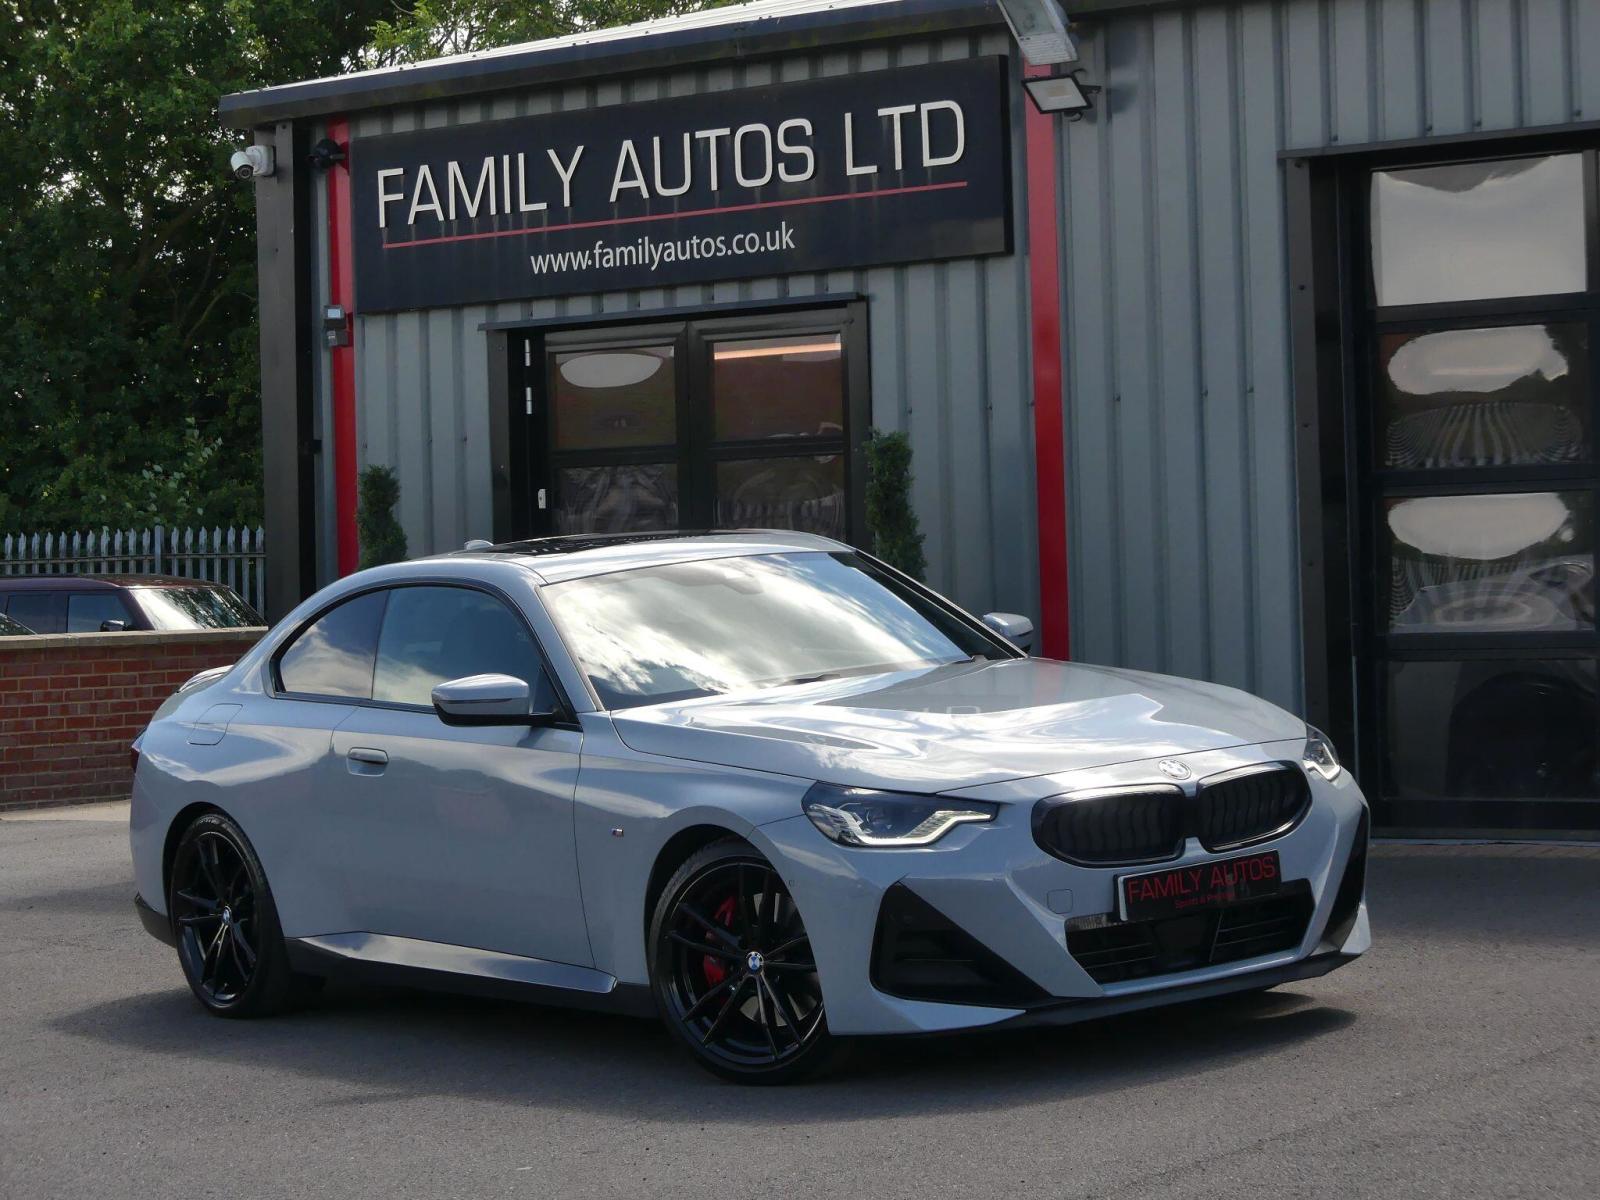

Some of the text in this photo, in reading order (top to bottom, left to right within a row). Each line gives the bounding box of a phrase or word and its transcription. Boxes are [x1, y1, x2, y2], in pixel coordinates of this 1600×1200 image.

[376, 100, 966, 228] FAMILY AUTOS LTD
[530, 220, 796, 275] www.familyautos.co.uk
[1126, 868, 1203, 904] FAMILY
[1210, 856, 1277, 889] AUTOS
